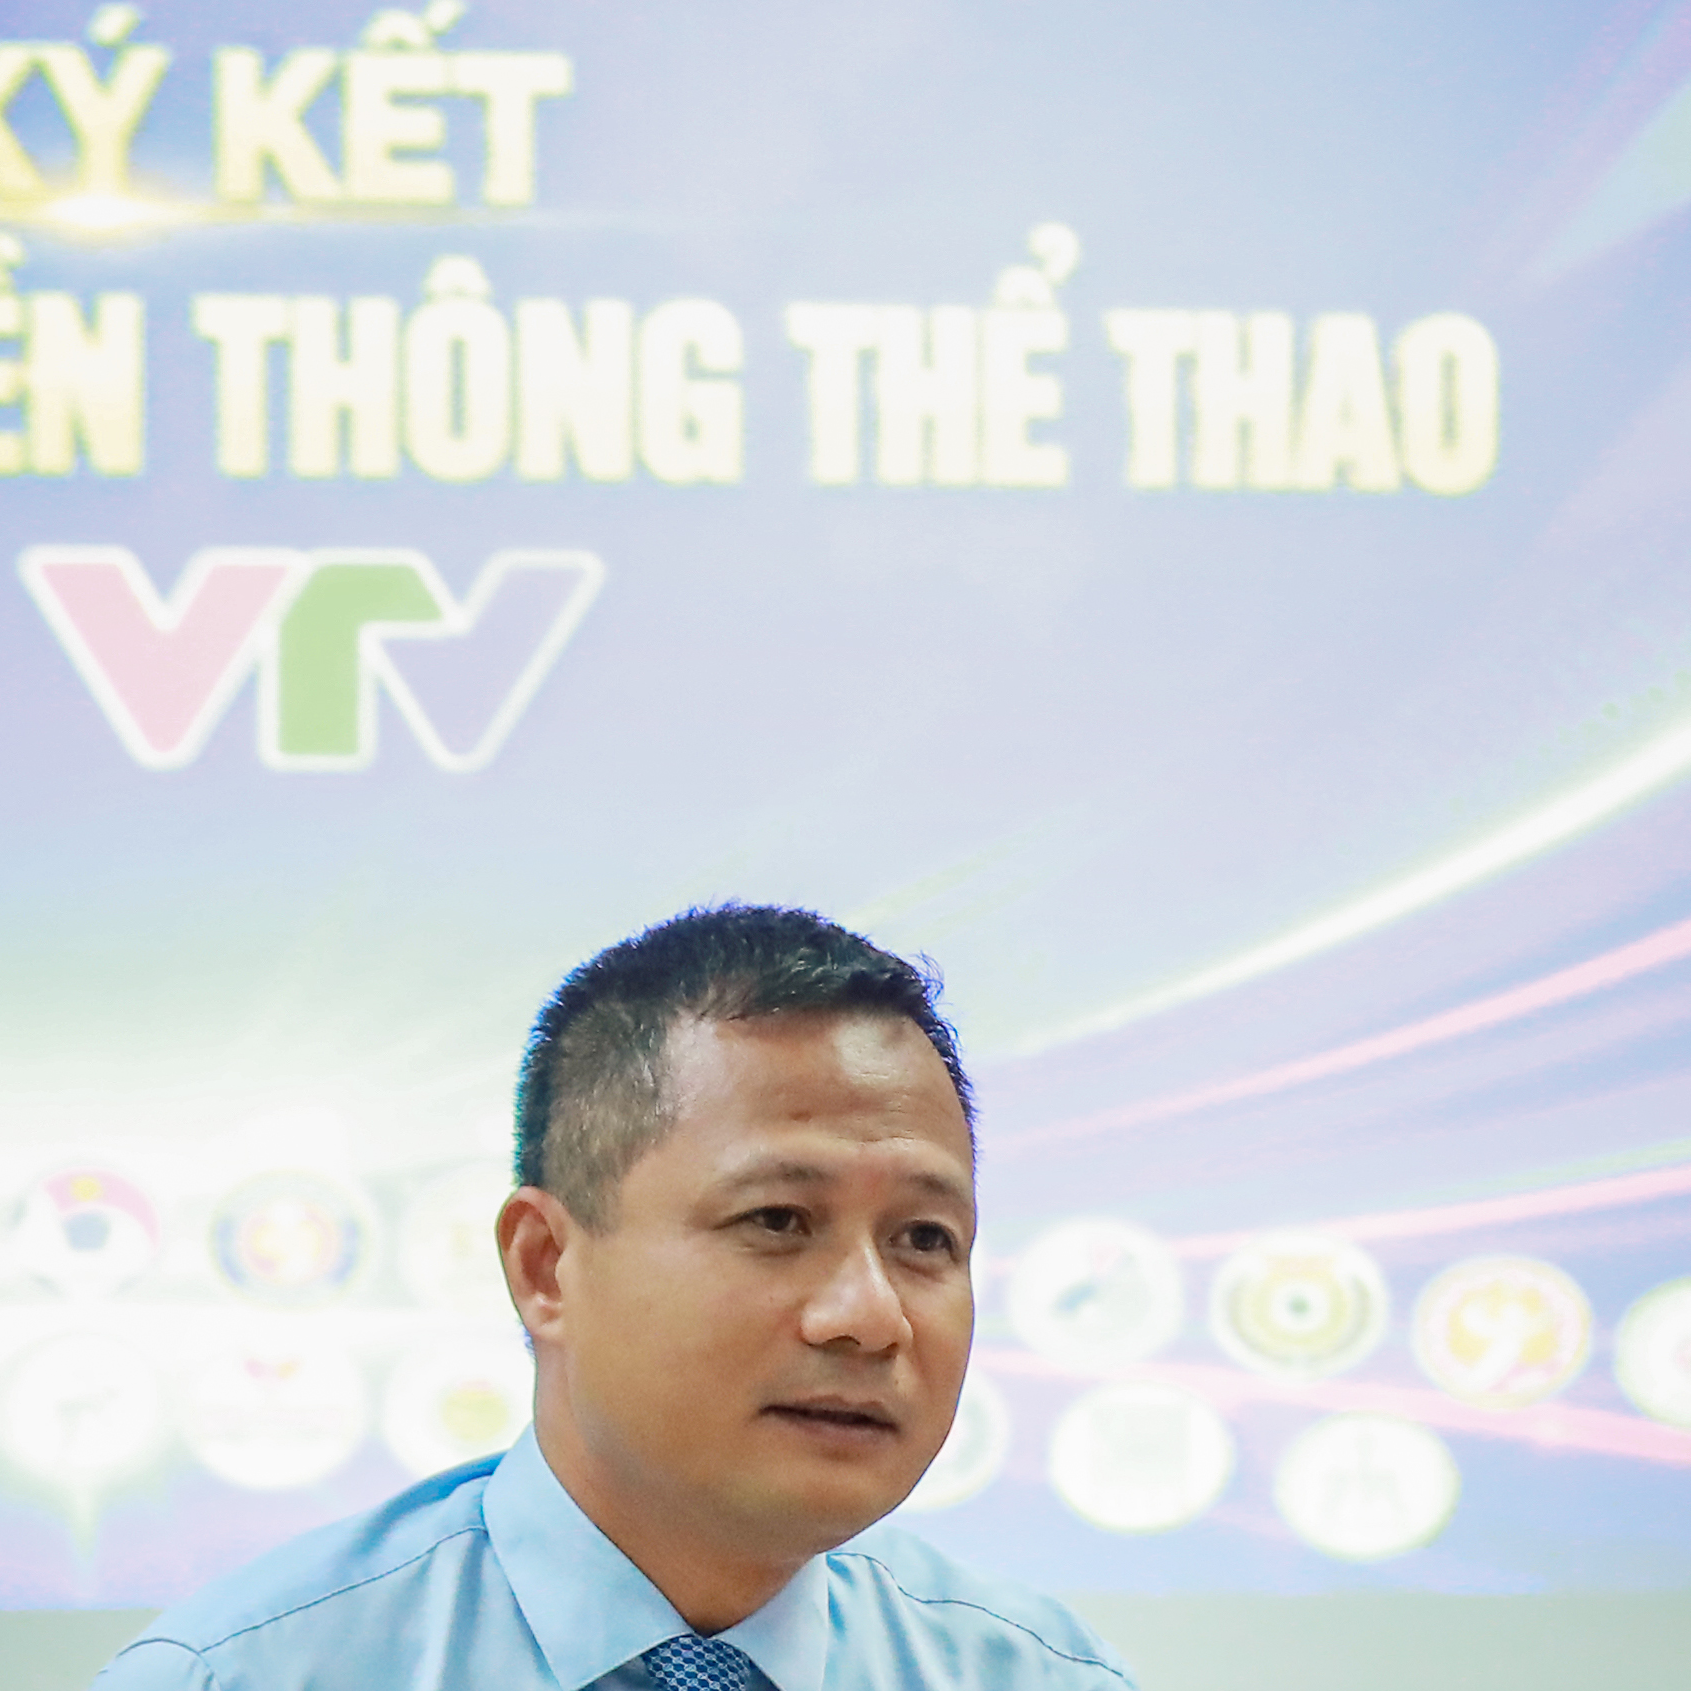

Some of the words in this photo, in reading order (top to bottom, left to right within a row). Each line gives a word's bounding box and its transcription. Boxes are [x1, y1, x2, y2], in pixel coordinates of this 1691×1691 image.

[214, 0, 573, 204] KẾT
[196, 255, 745, 484] THÔNG
[787, 222, 1079, 490] THỂ
[1105, 308, 1501, 496] THAO
[19, 546, 606, 770] VTV
